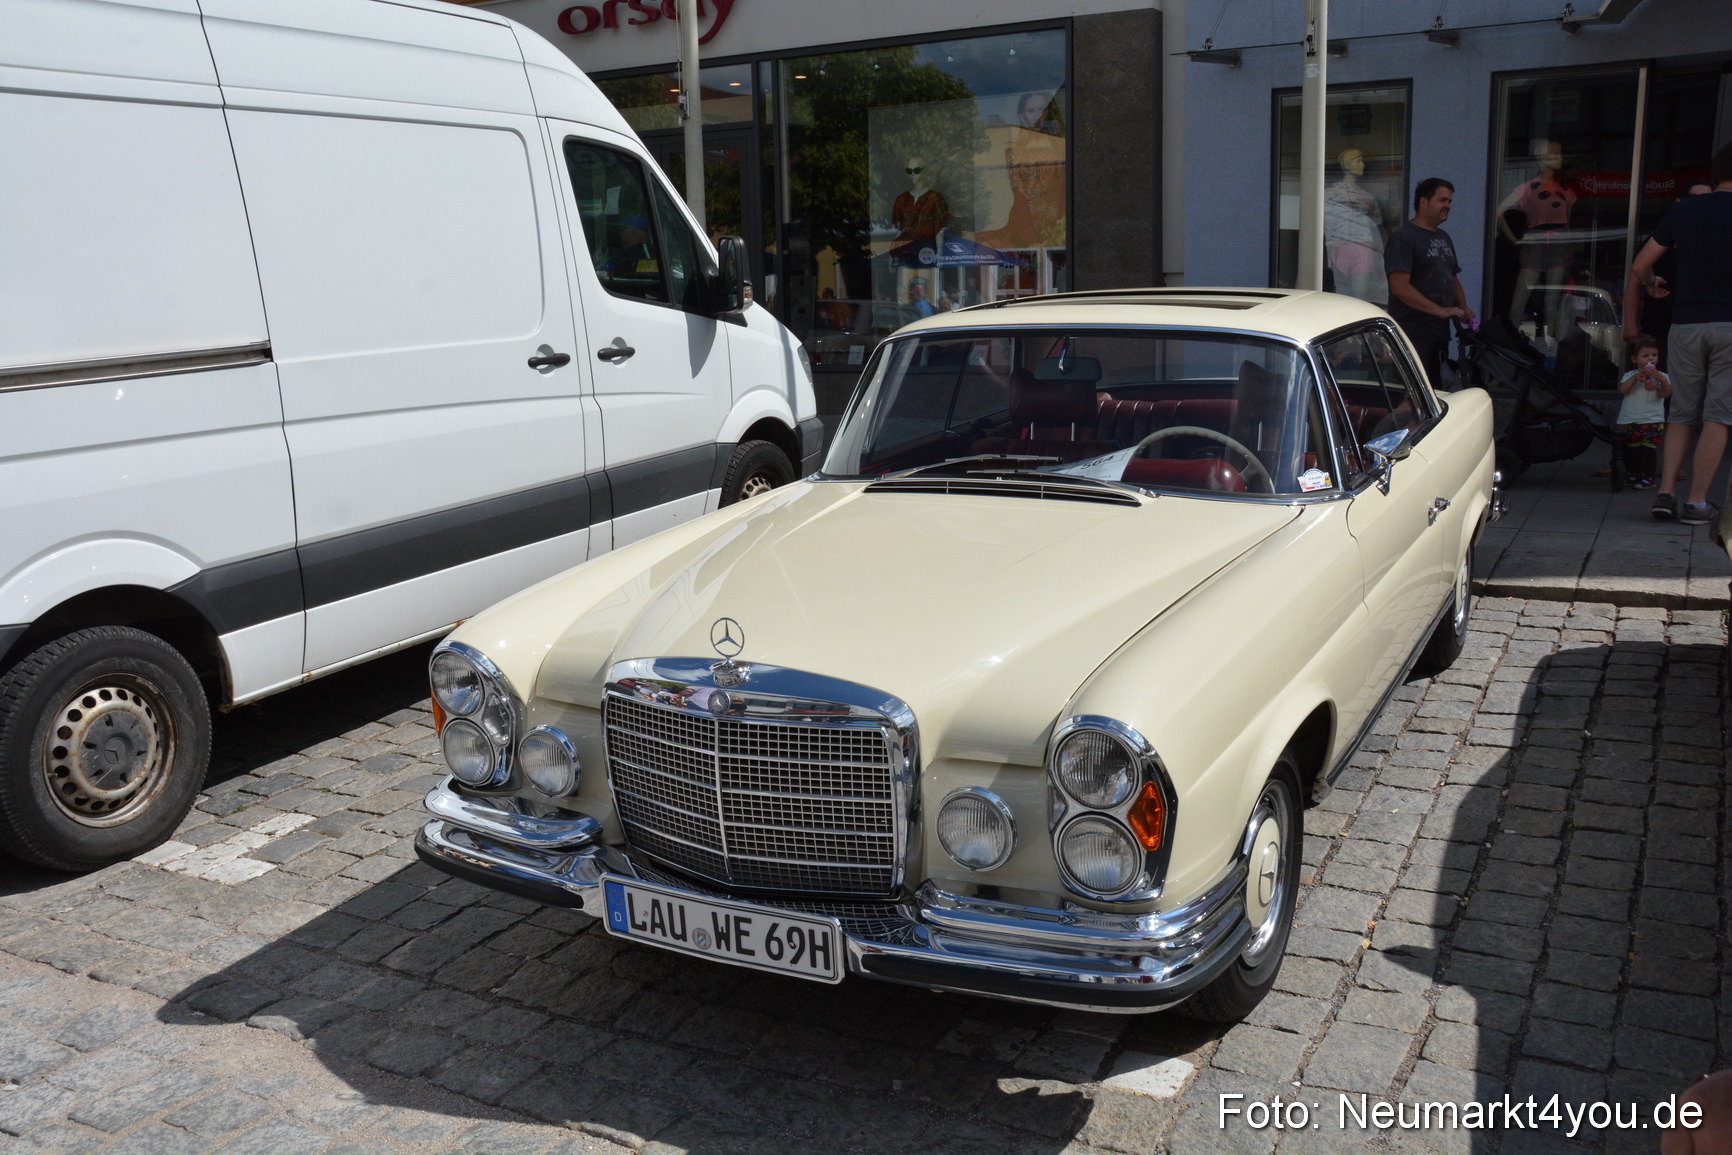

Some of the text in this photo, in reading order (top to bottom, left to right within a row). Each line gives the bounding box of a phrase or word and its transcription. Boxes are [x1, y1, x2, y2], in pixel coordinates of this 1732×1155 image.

[1081, 454, 1115, 470] 564
[613, 911, 622, 923] D
[627, 892, 831, 971] LAU WE 69H
